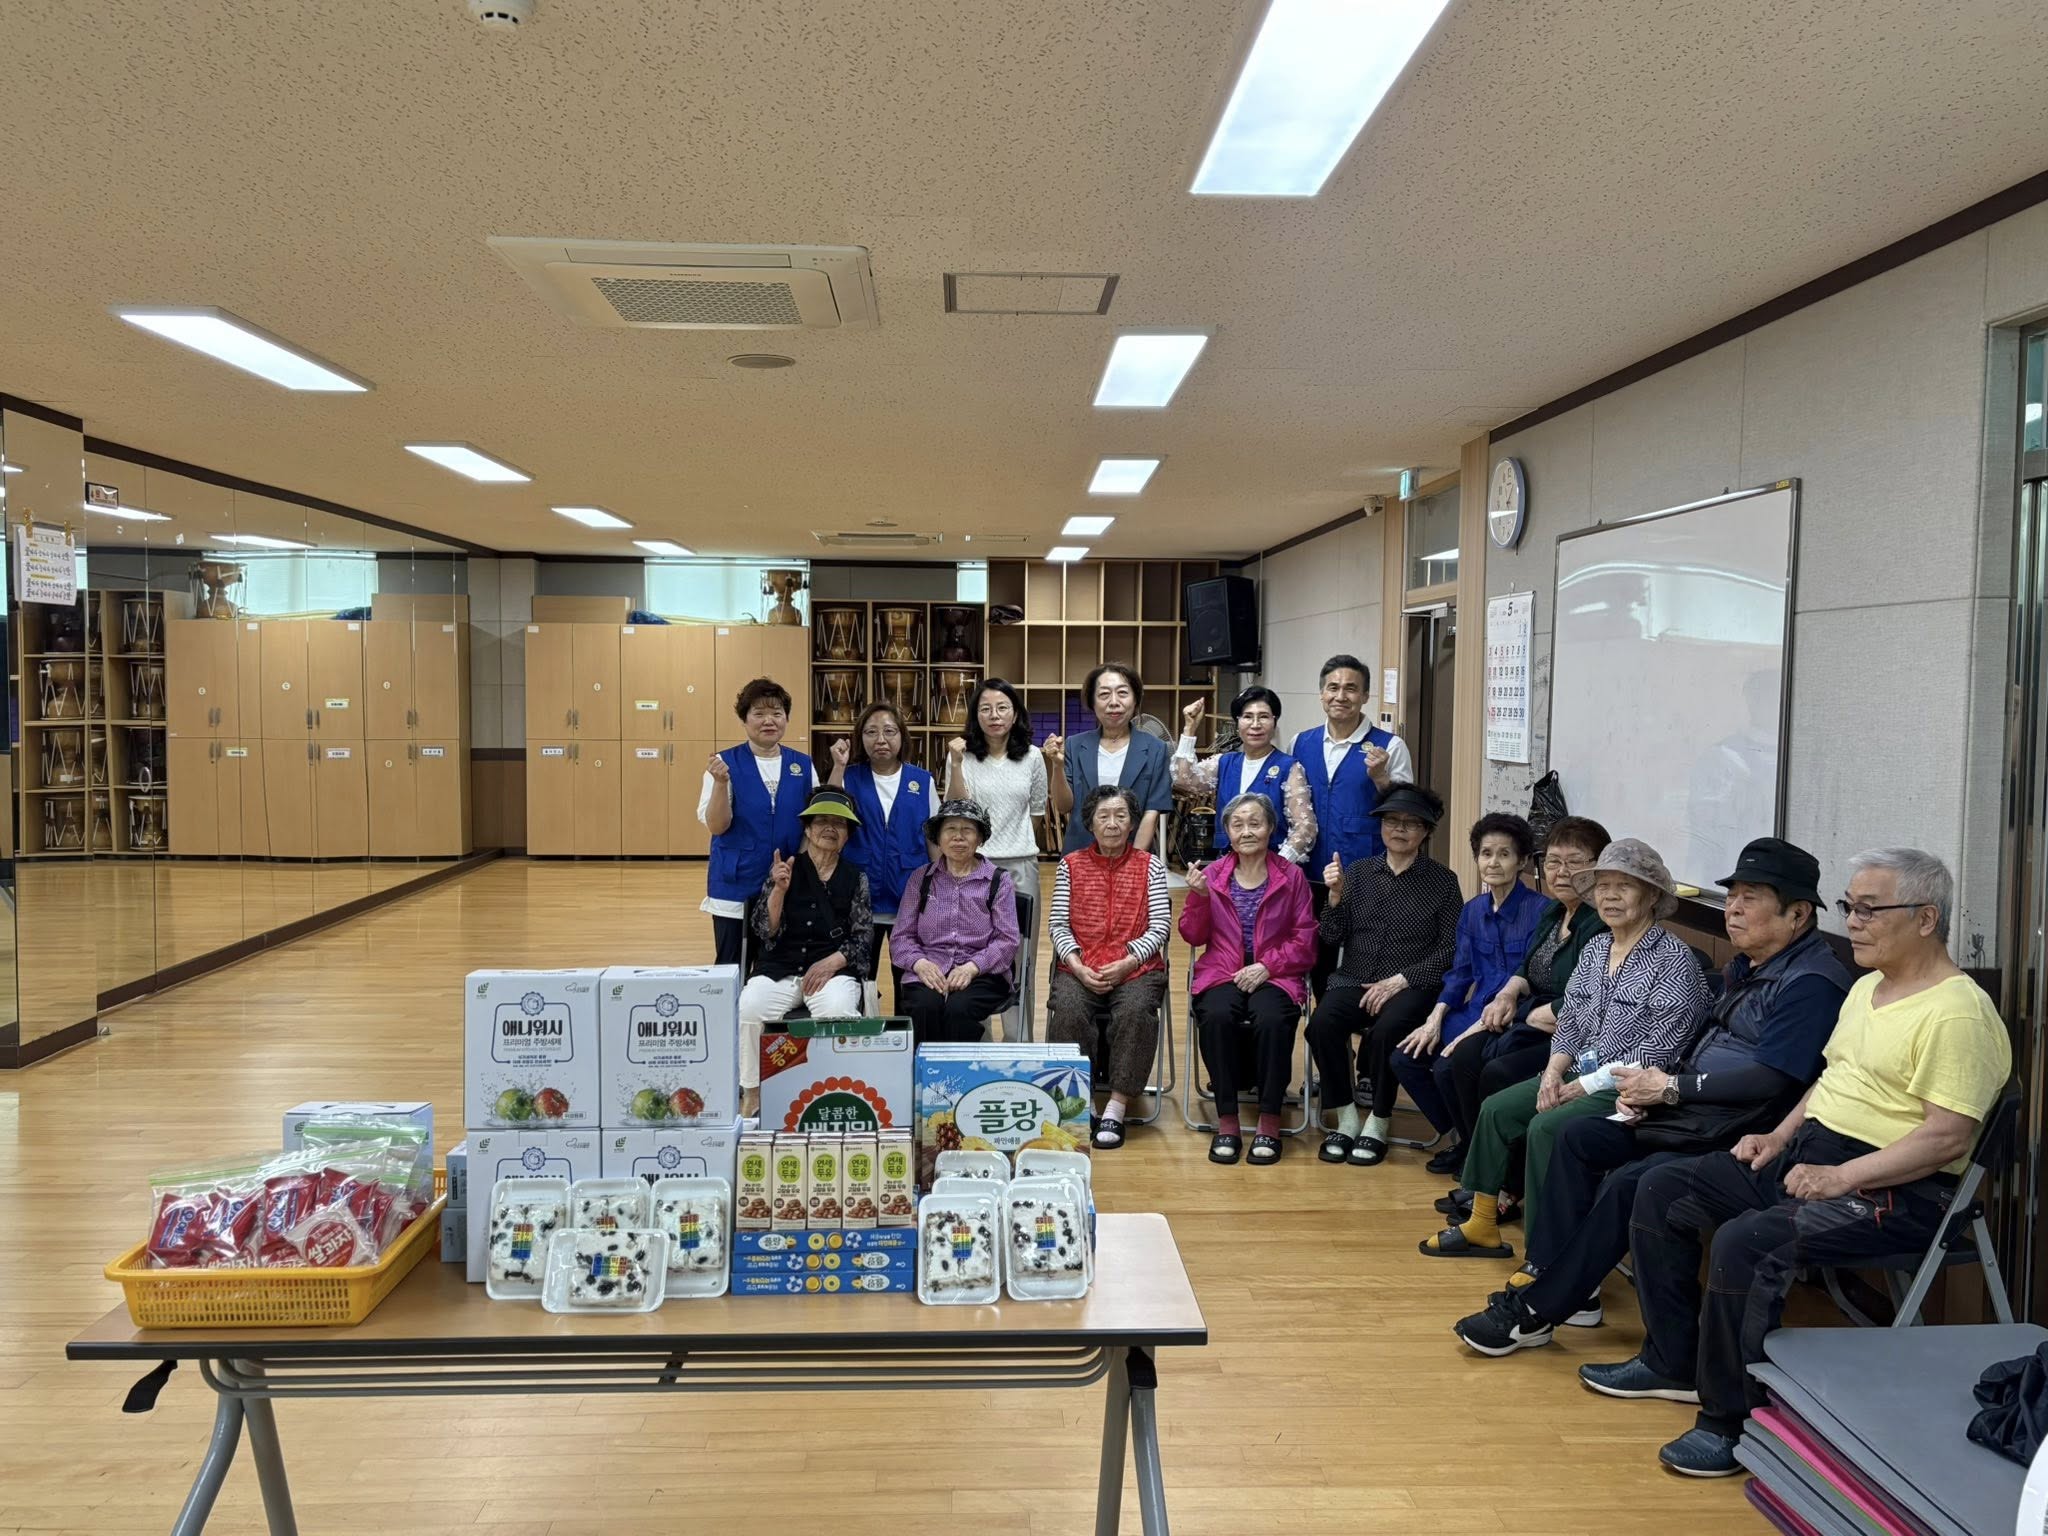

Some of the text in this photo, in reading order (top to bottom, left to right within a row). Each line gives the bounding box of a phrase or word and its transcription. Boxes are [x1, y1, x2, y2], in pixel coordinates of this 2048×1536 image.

[1507, 602, 1513, 616] 5
[502, 1019, 563, 1036] 애니워시
[637, 1020, 698, 1037] 애니워시
[503, 1037, 562, 1047] 프리미엄 주방세제
[638, 1038, 697, 1048] 프리미엄 주방세제
[818, 1106, 859, 1121] 달콤한
[973, 1098, 1044, 1134] 플랑
[993, 1136, 1021, 1145] 파인애플
[745, 1159, 762, 1168] 연세
[781, 1160, 797, 1169] 연세
[816, 1159, 832, 1168] 연세
[851, 1159, 868, 1168] 연세
[886, 1156, 903, 1165] 연세
[746, 1169, 761, 1177] 두유
[782, 1169, 797, 1178] 두유
[817, 1168, 832, 1177] 두유
[852, 1169, 867, 1177] 두유
[887, 1165, 903, 1175] 두유
[307, 1226, 354, 1261] 쌀과자
